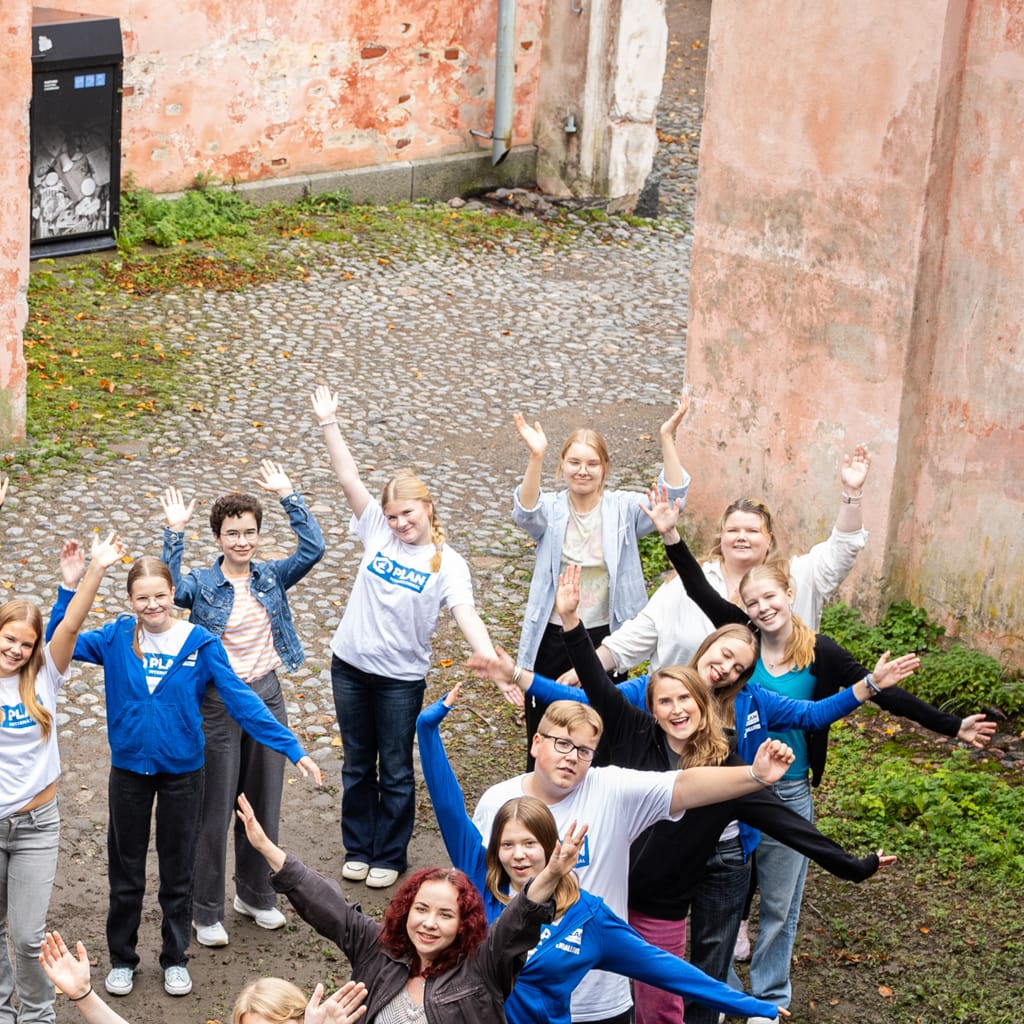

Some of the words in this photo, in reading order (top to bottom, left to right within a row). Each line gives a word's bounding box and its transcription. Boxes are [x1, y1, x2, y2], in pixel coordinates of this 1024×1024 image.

[392, 567, 426, 587] PLAN
[149, 656, 174, 670] PLA
[8, 708, 29, 721] PL
